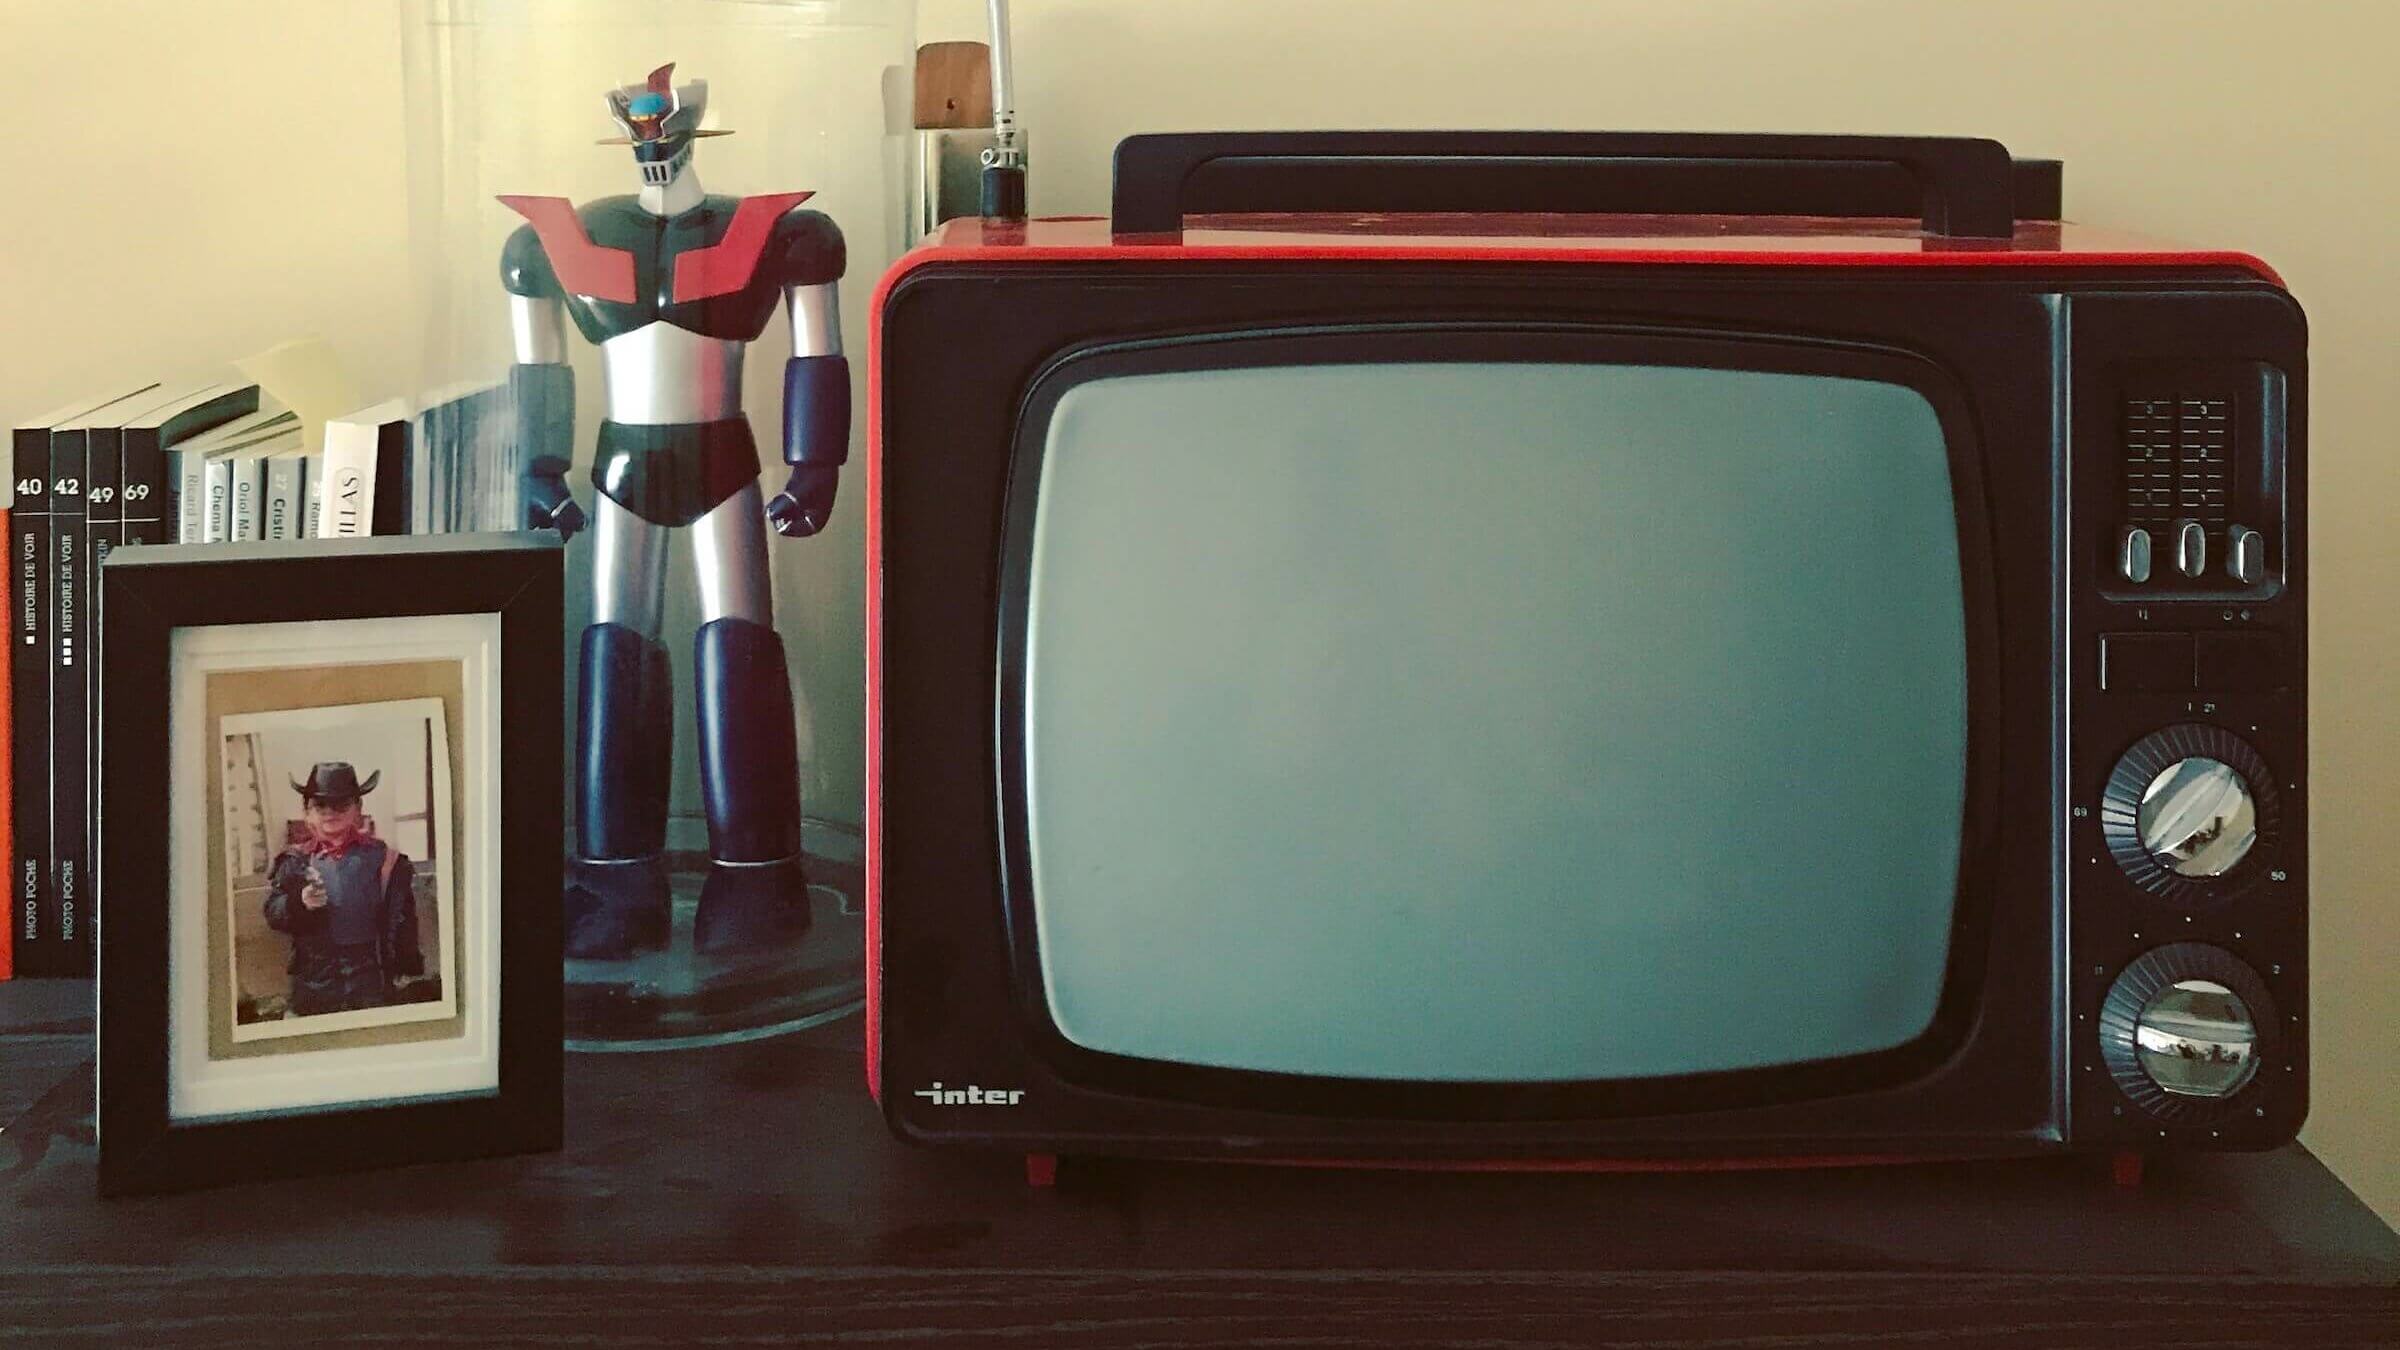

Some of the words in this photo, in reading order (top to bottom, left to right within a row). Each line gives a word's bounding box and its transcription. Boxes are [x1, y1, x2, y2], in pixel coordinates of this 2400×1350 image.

[2200, 404, 2208, 415] 3
[2200, 448, 2208, 458] 2
[16, 478, 42, 496] 40
[54, 478, 79, 495] 42
[89, 487, 114, 504] 49
[124, 484, 149, 500] 69
[239, 482, 251, 513] Oriol
[211, 485, 225, 532] Chema
[238, 519, 249, 541] Ma
[24, 532, 36, 561] VOIR
[61, 534, 73, 562] VOIR
[24, 562, 36, 578] DE
[61, 564, 73, 580] DE
[25, 580, 36, 631] HISTOIRE
[62, 581, 73, 632] HISTOIRE
[2073, 806, 2088, 817] 69
[25, 859, 37, 899] POCHE
[63, 860, 74, 899] POCHE
[2271, 870, 2286, 881] 50
[26, 900, 37, 939] PHOTO
[63, 901, 74, 940] PHOTO
[914, 1081, 1025, 1105] inter
